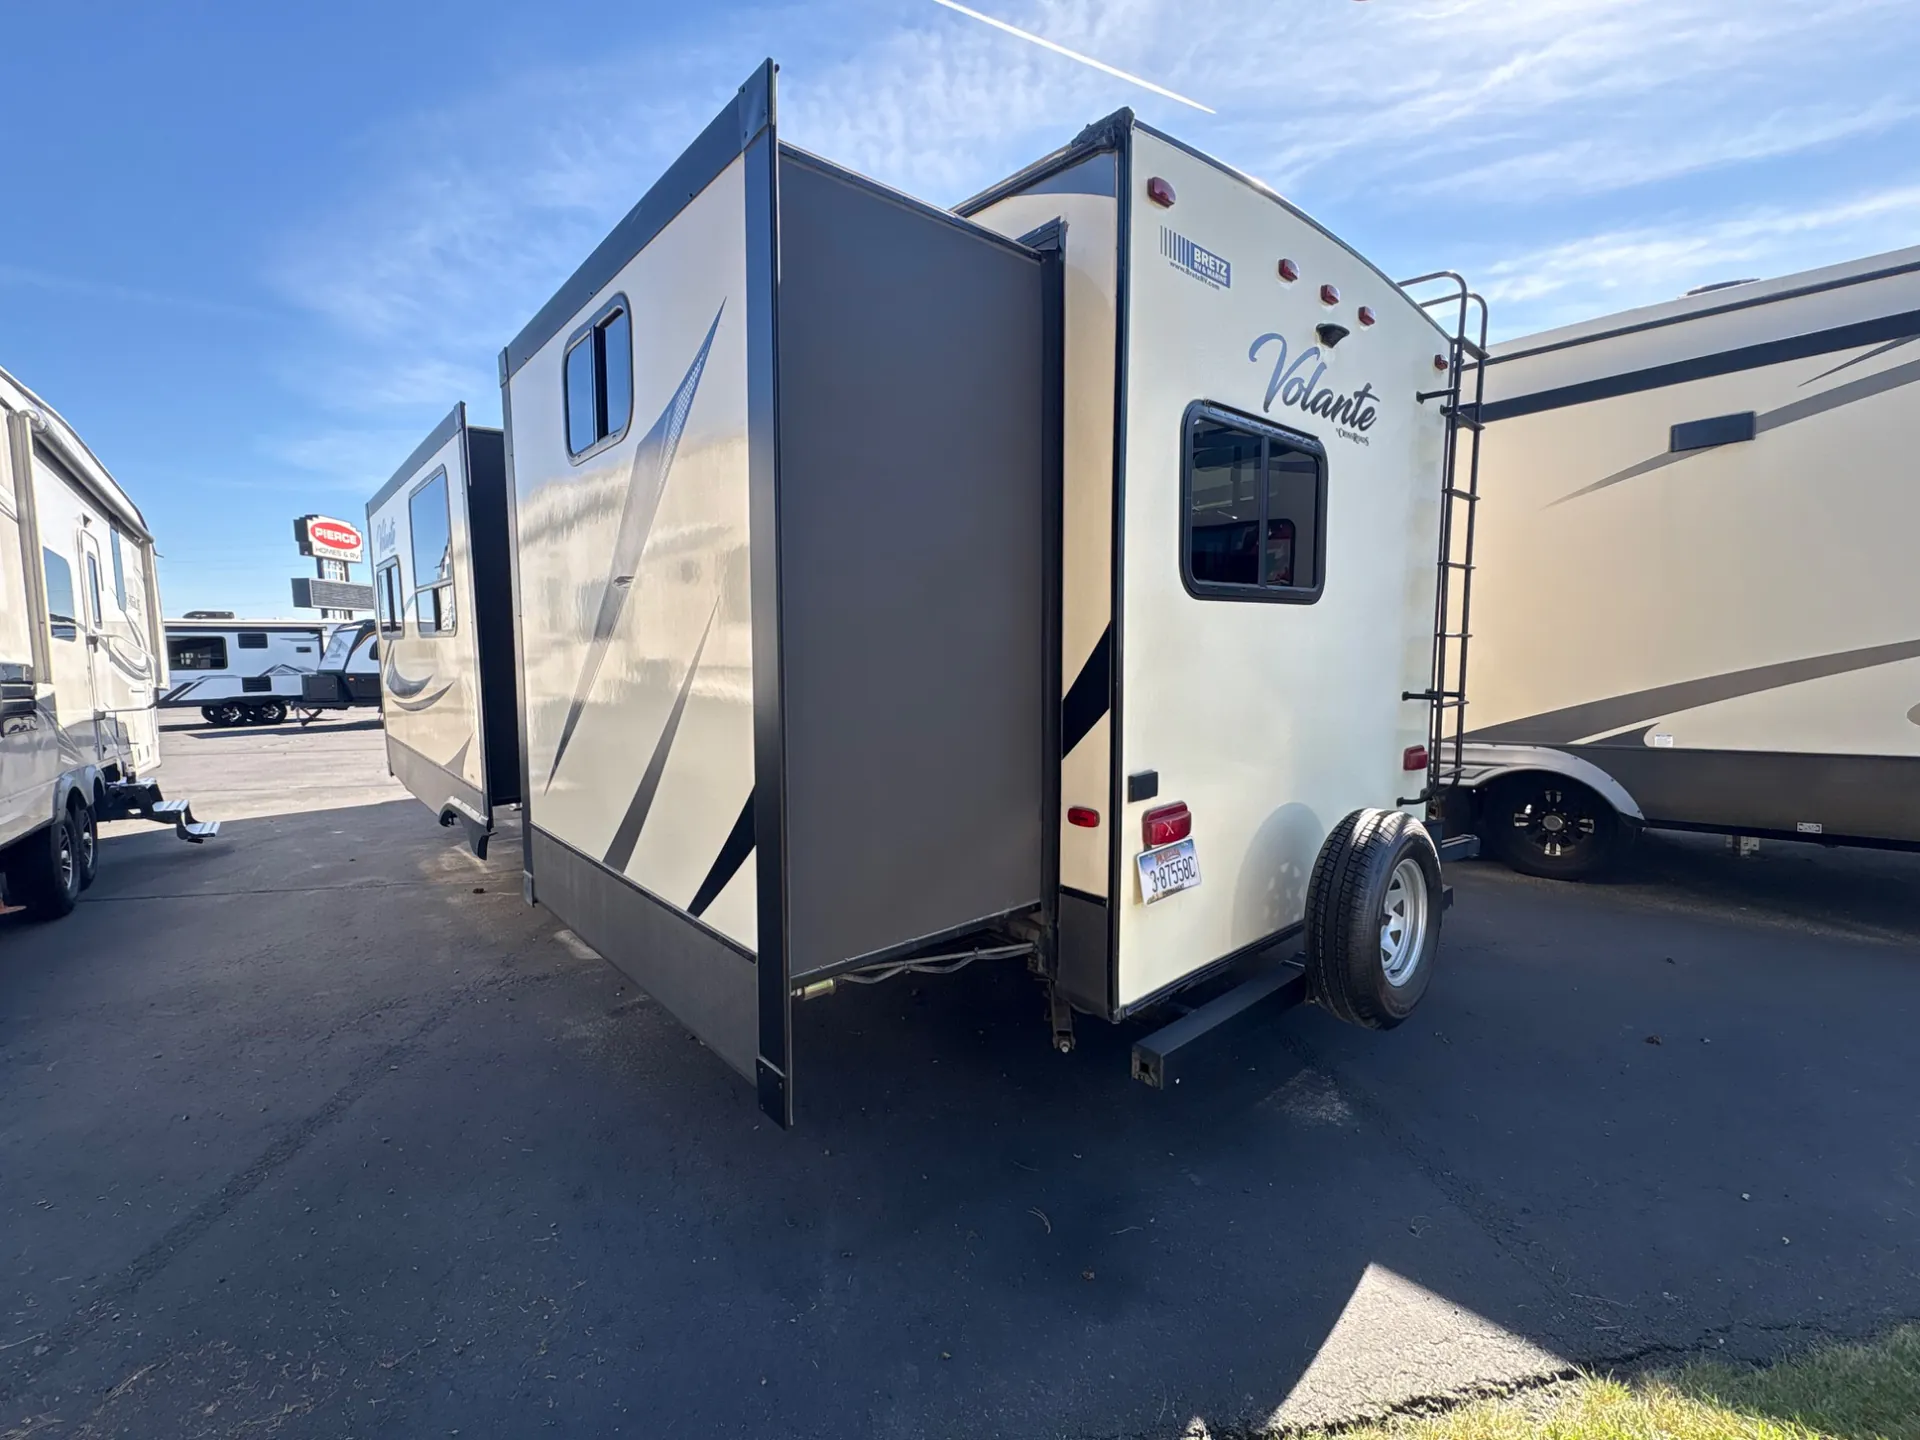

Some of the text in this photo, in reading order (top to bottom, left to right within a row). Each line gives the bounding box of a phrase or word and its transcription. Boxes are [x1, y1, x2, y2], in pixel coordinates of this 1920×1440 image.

[1194, 247, 1228, 277] BRETZ
[1249, 333, 1380, 431] Volante
[314, 527, 358, 545] PIERCE
[315, 546, 342, 557] HOMES
[350, 552, 360, 560] RV
